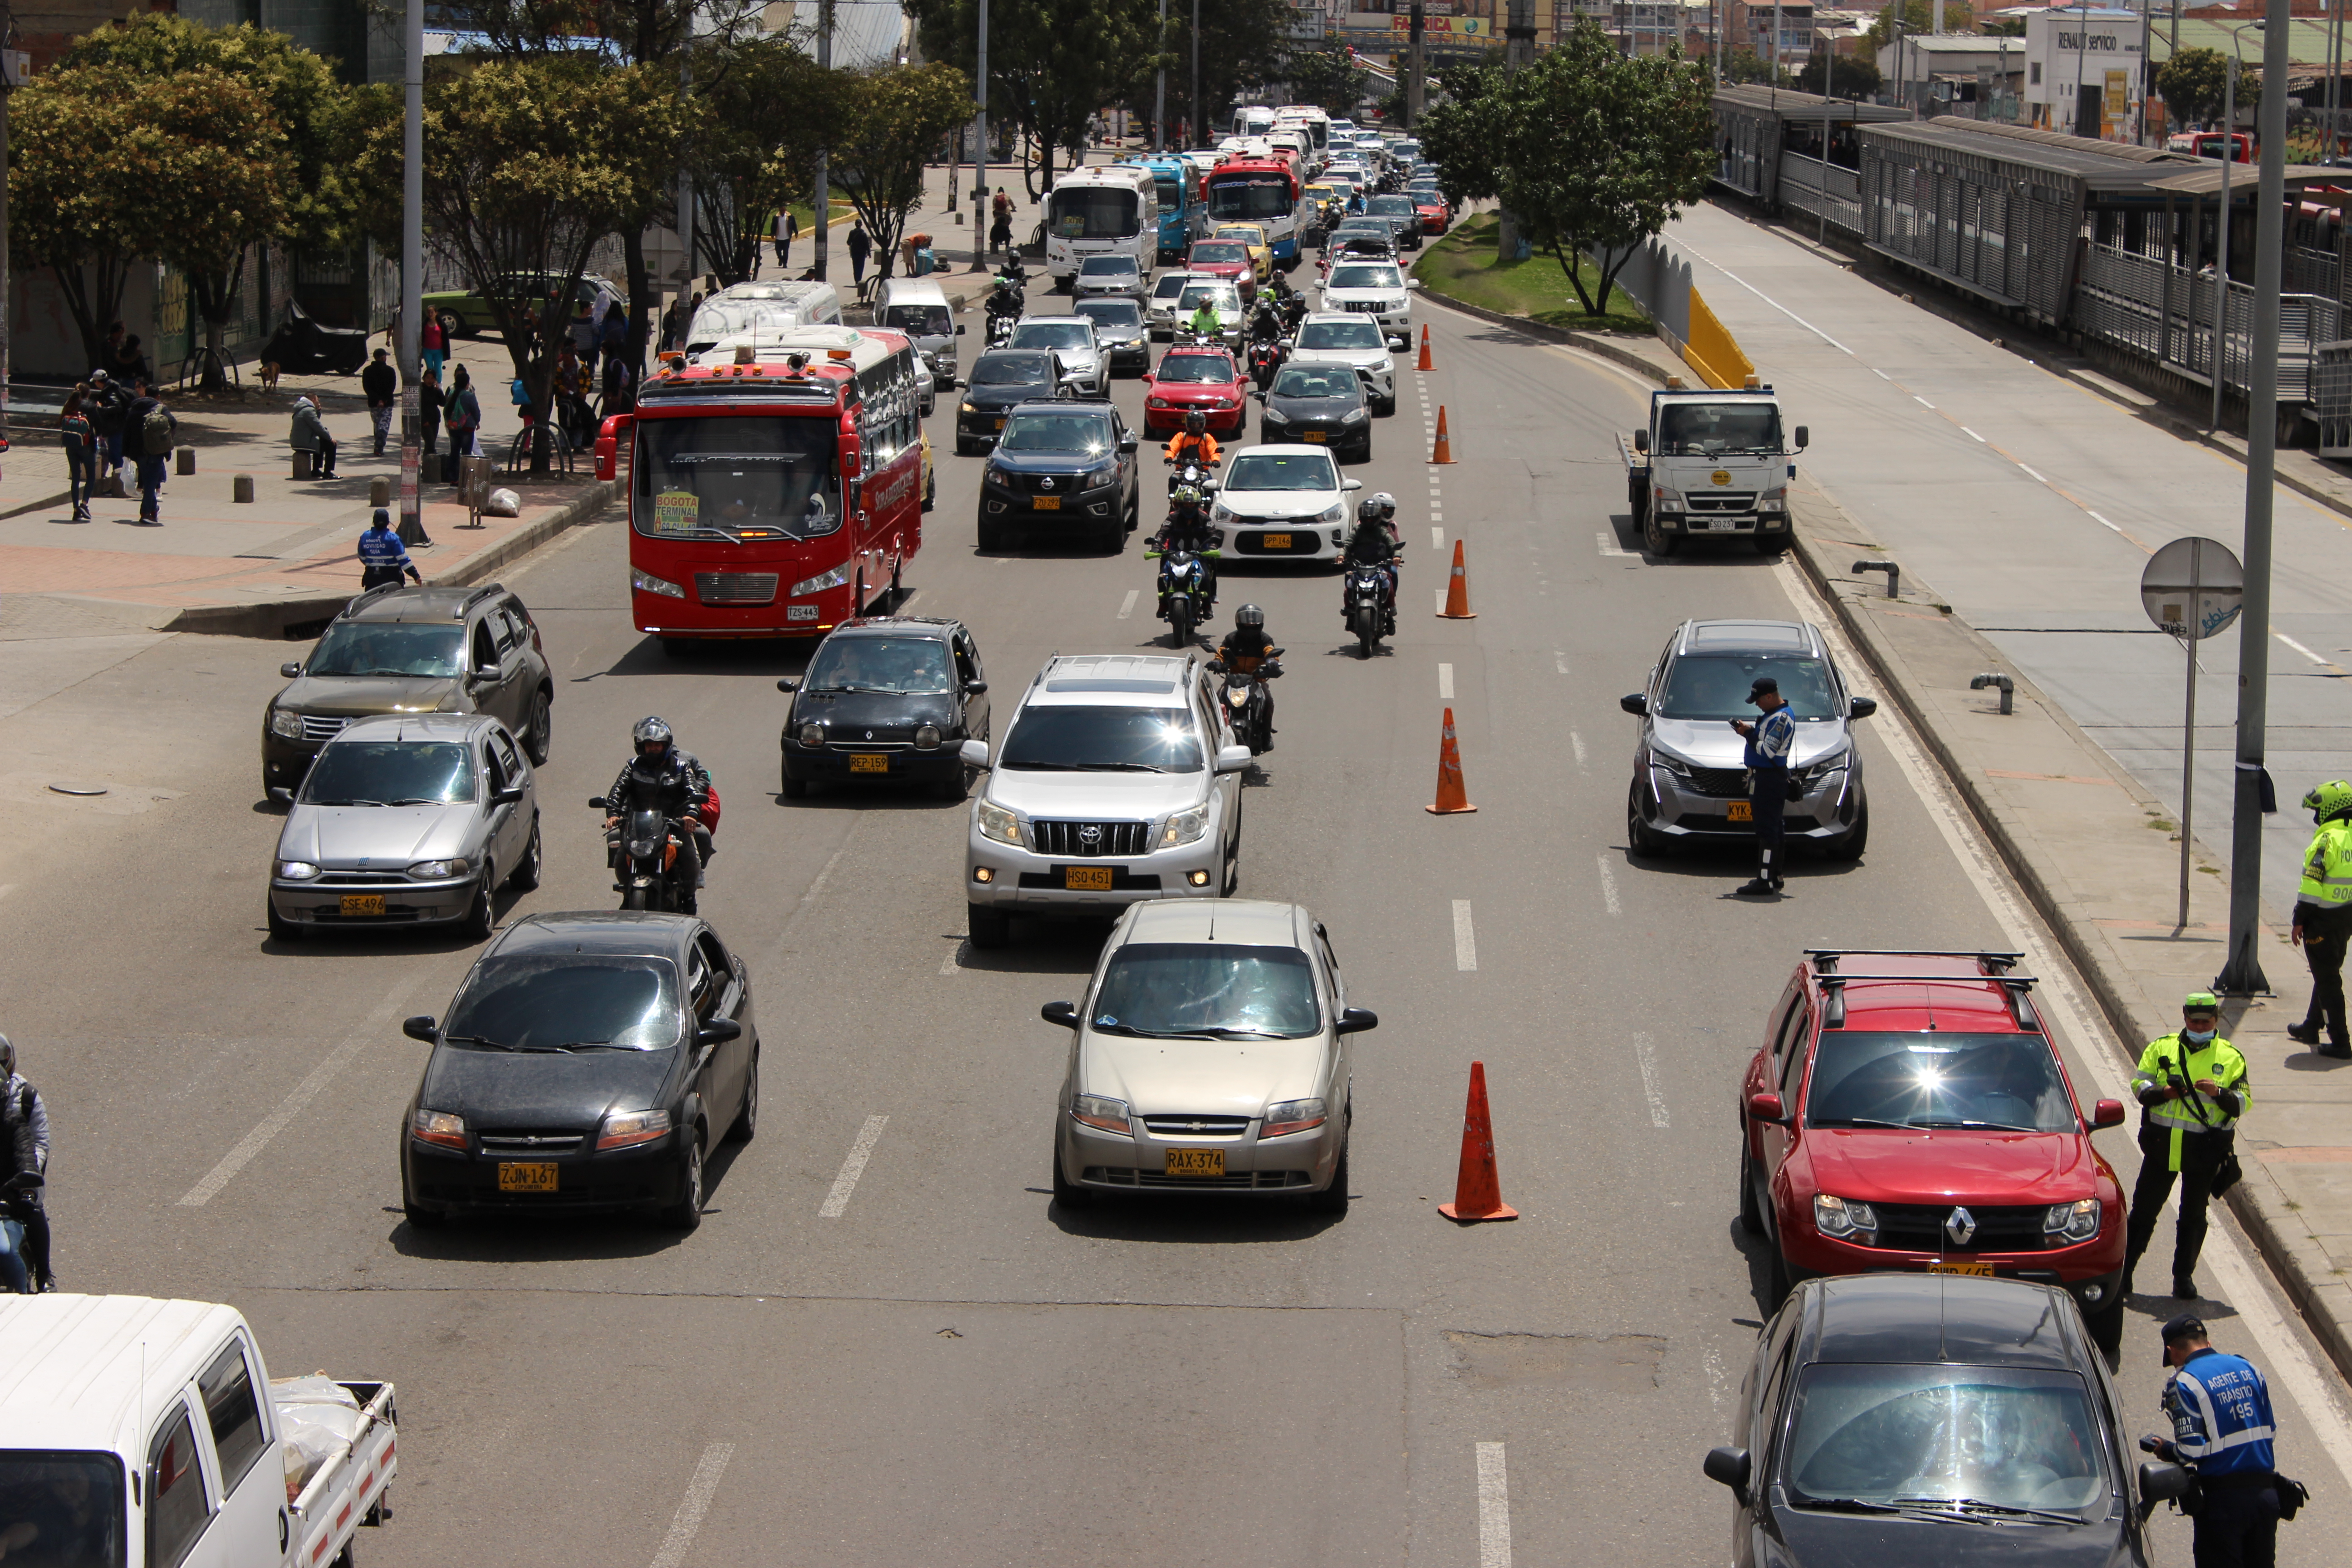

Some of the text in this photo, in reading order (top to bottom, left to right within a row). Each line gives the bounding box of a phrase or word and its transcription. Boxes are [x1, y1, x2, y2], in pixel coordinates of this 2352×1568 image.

[657, 496, 697, 507] BOGOTA
[657, 506, 696, 517] TERMINAL
[2207, 1370, 2253, 1390] AGENTE DE
[2216, 1385, 2253, 1405] TRÁNSITO
[2229, 1402, 2254, 1421] 195
